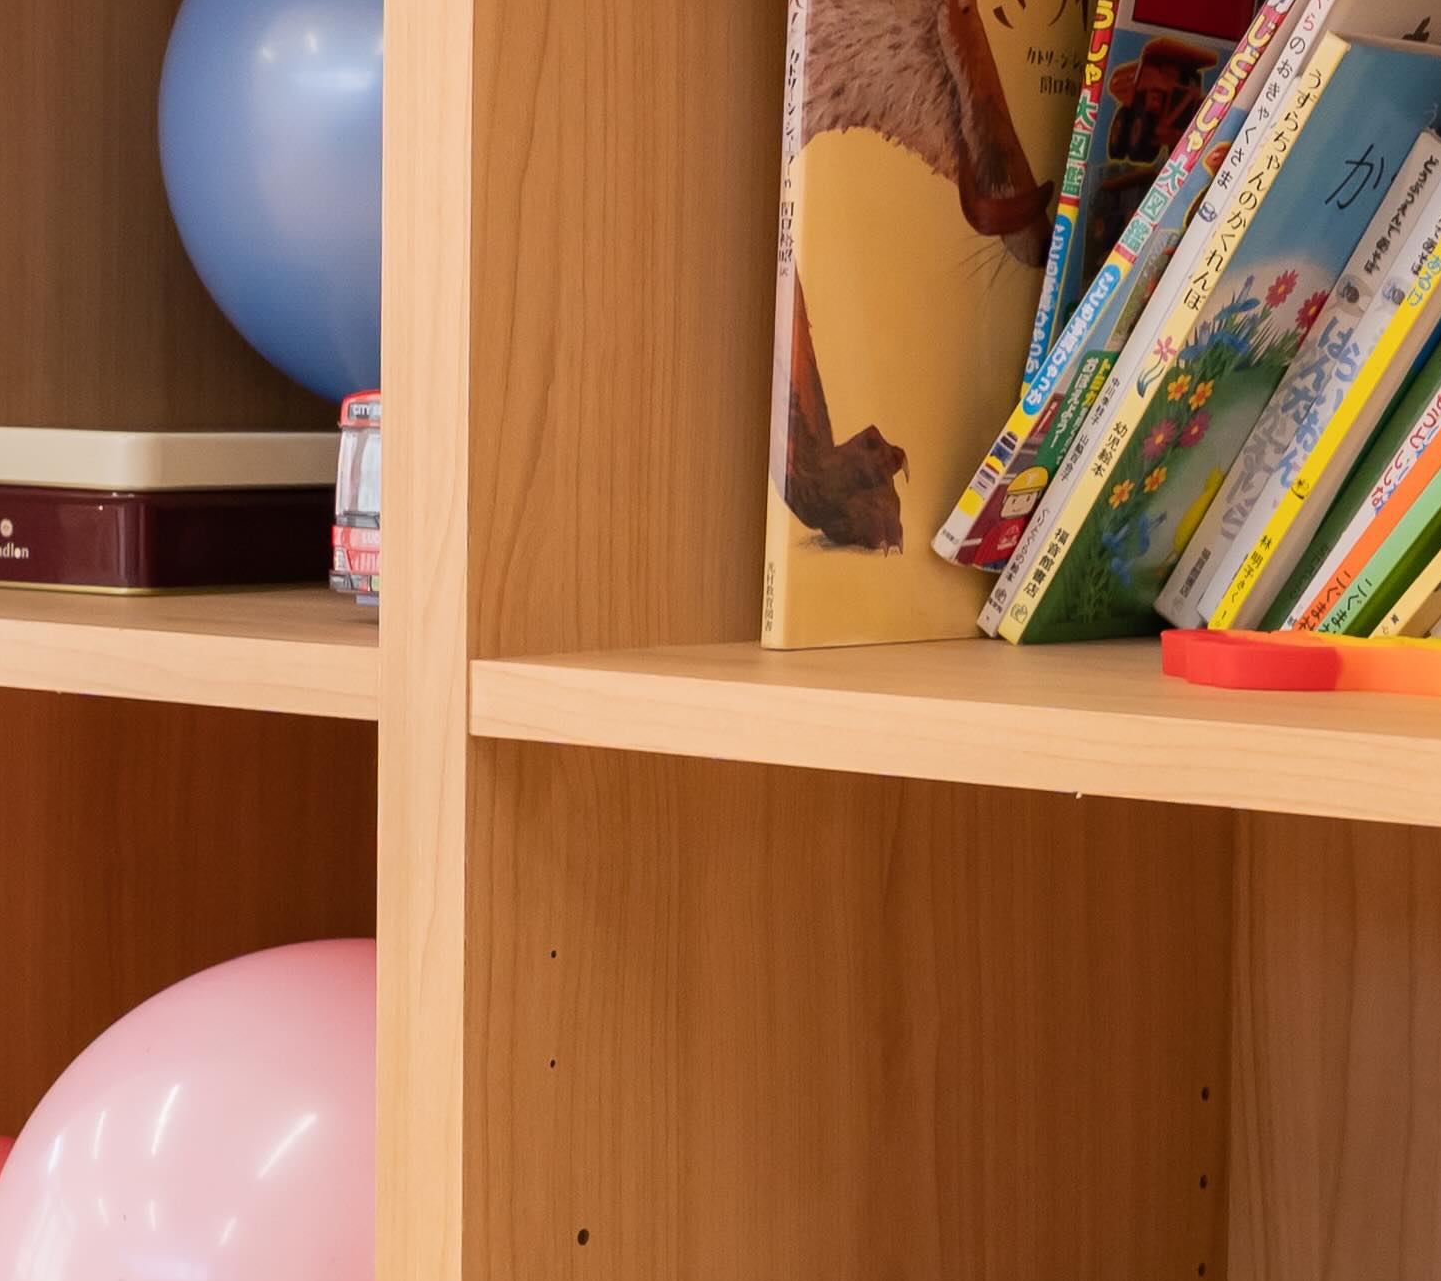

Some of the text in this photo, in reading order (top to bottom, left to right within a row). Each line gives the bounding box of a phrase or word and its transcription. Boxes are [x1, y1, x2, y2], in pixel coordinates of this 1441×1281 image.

[1183, 68, 1323, 312] うずらちゃんのかくれんぼ
[1090, 420, 1129, 479] 幼児絵本
[1022, 527, 1071, 599] 福音館書店
